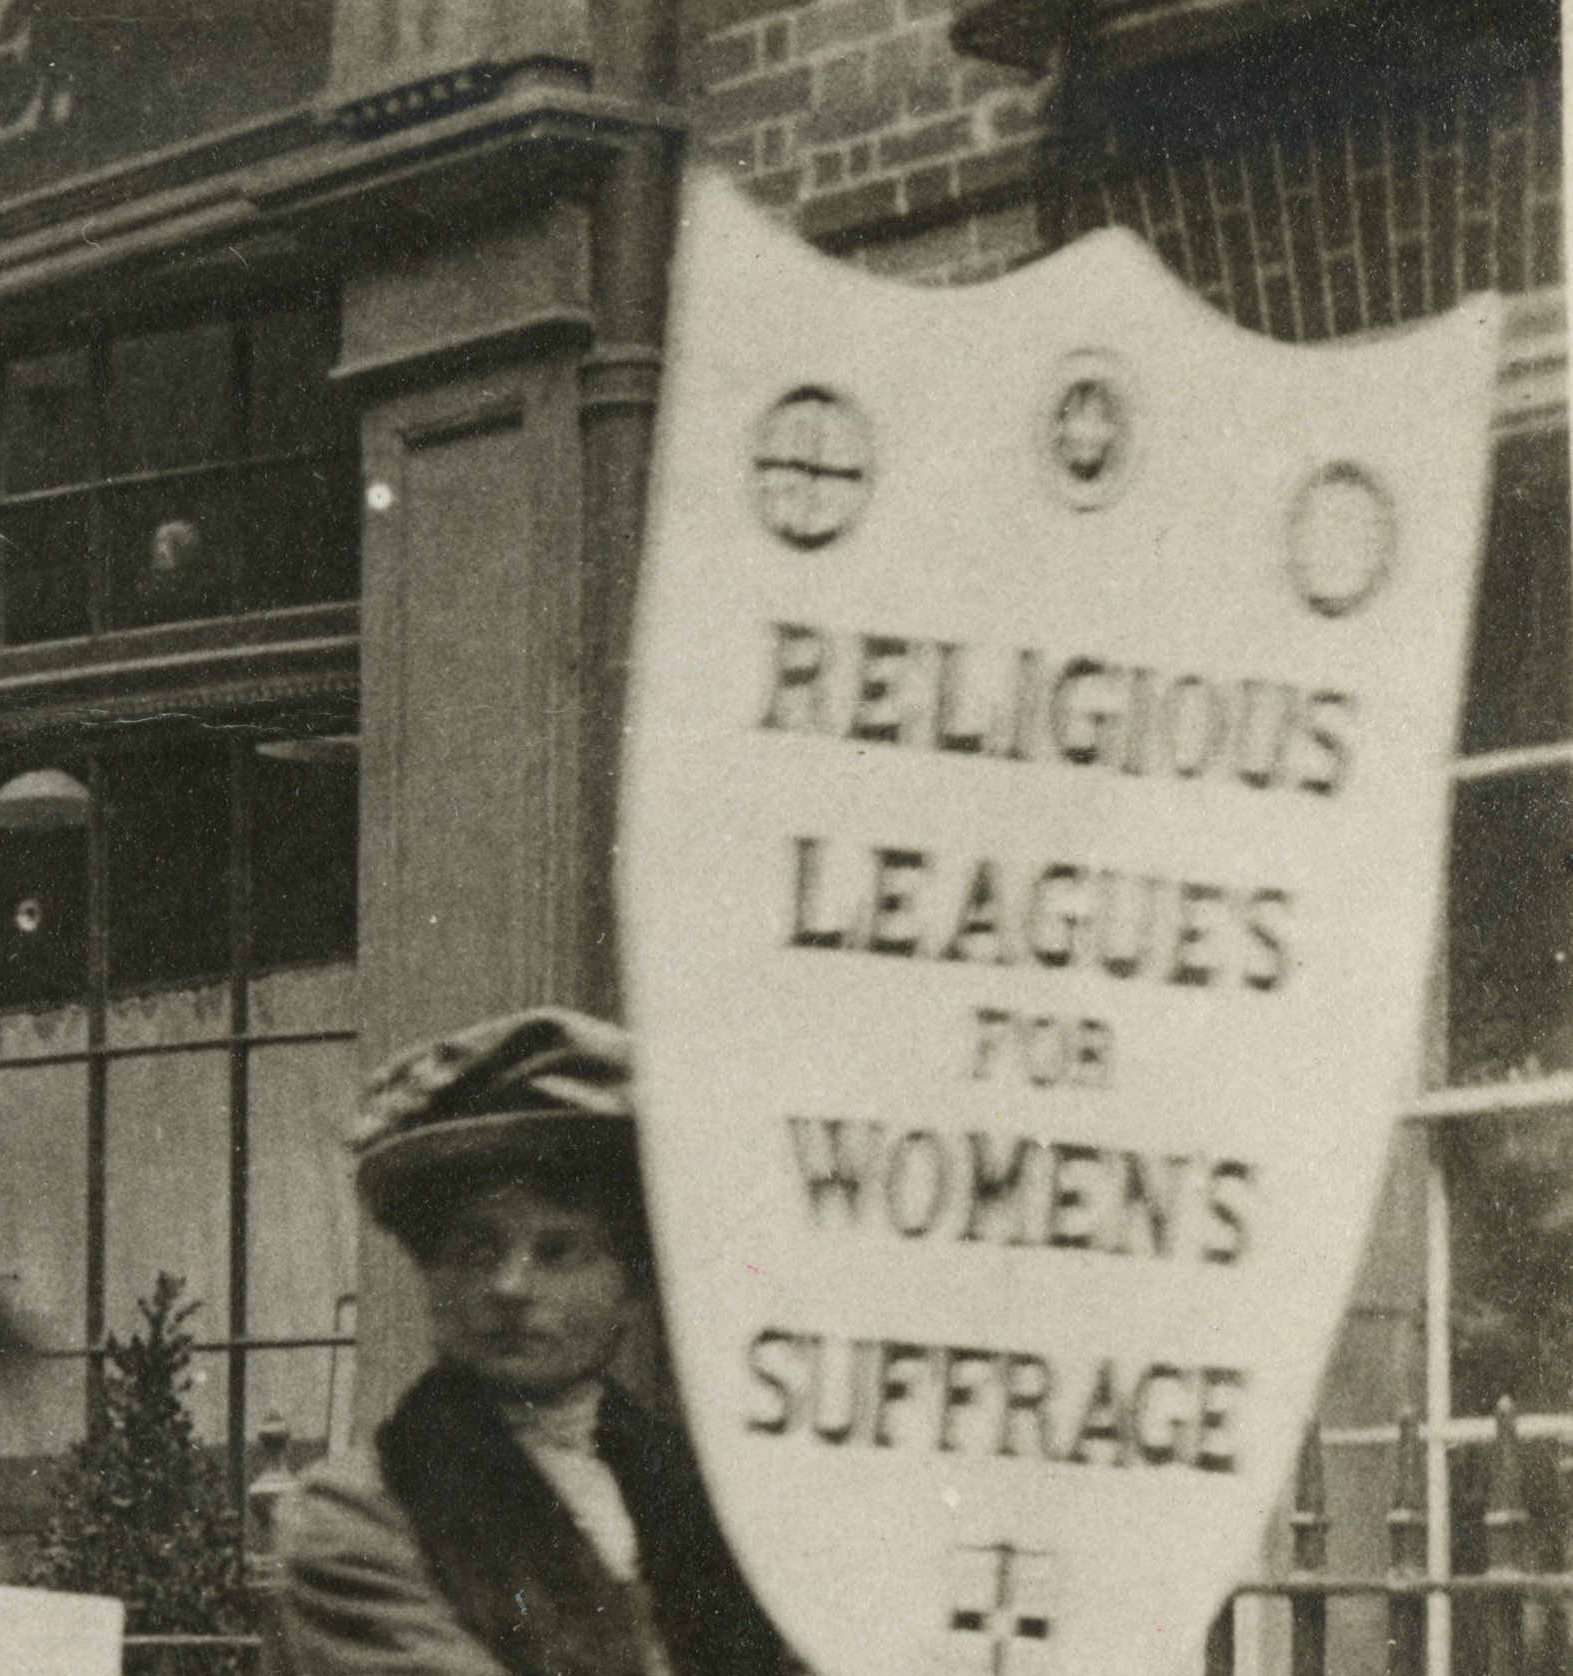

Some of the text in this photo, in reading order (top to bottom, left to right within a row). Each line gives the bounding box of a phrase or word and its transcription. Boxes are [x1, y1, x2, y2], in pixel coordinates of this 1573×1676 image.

[756, 618, 1357, 796] RELIGIOUS
[787, 834, 1295, 994] LEAGUES
[971, 1006, 1115, 1089] FOR
[787, 1114, 1253, 1267] WOMENS
[746, 1325, 1249, 1475] SUFFRAGE
